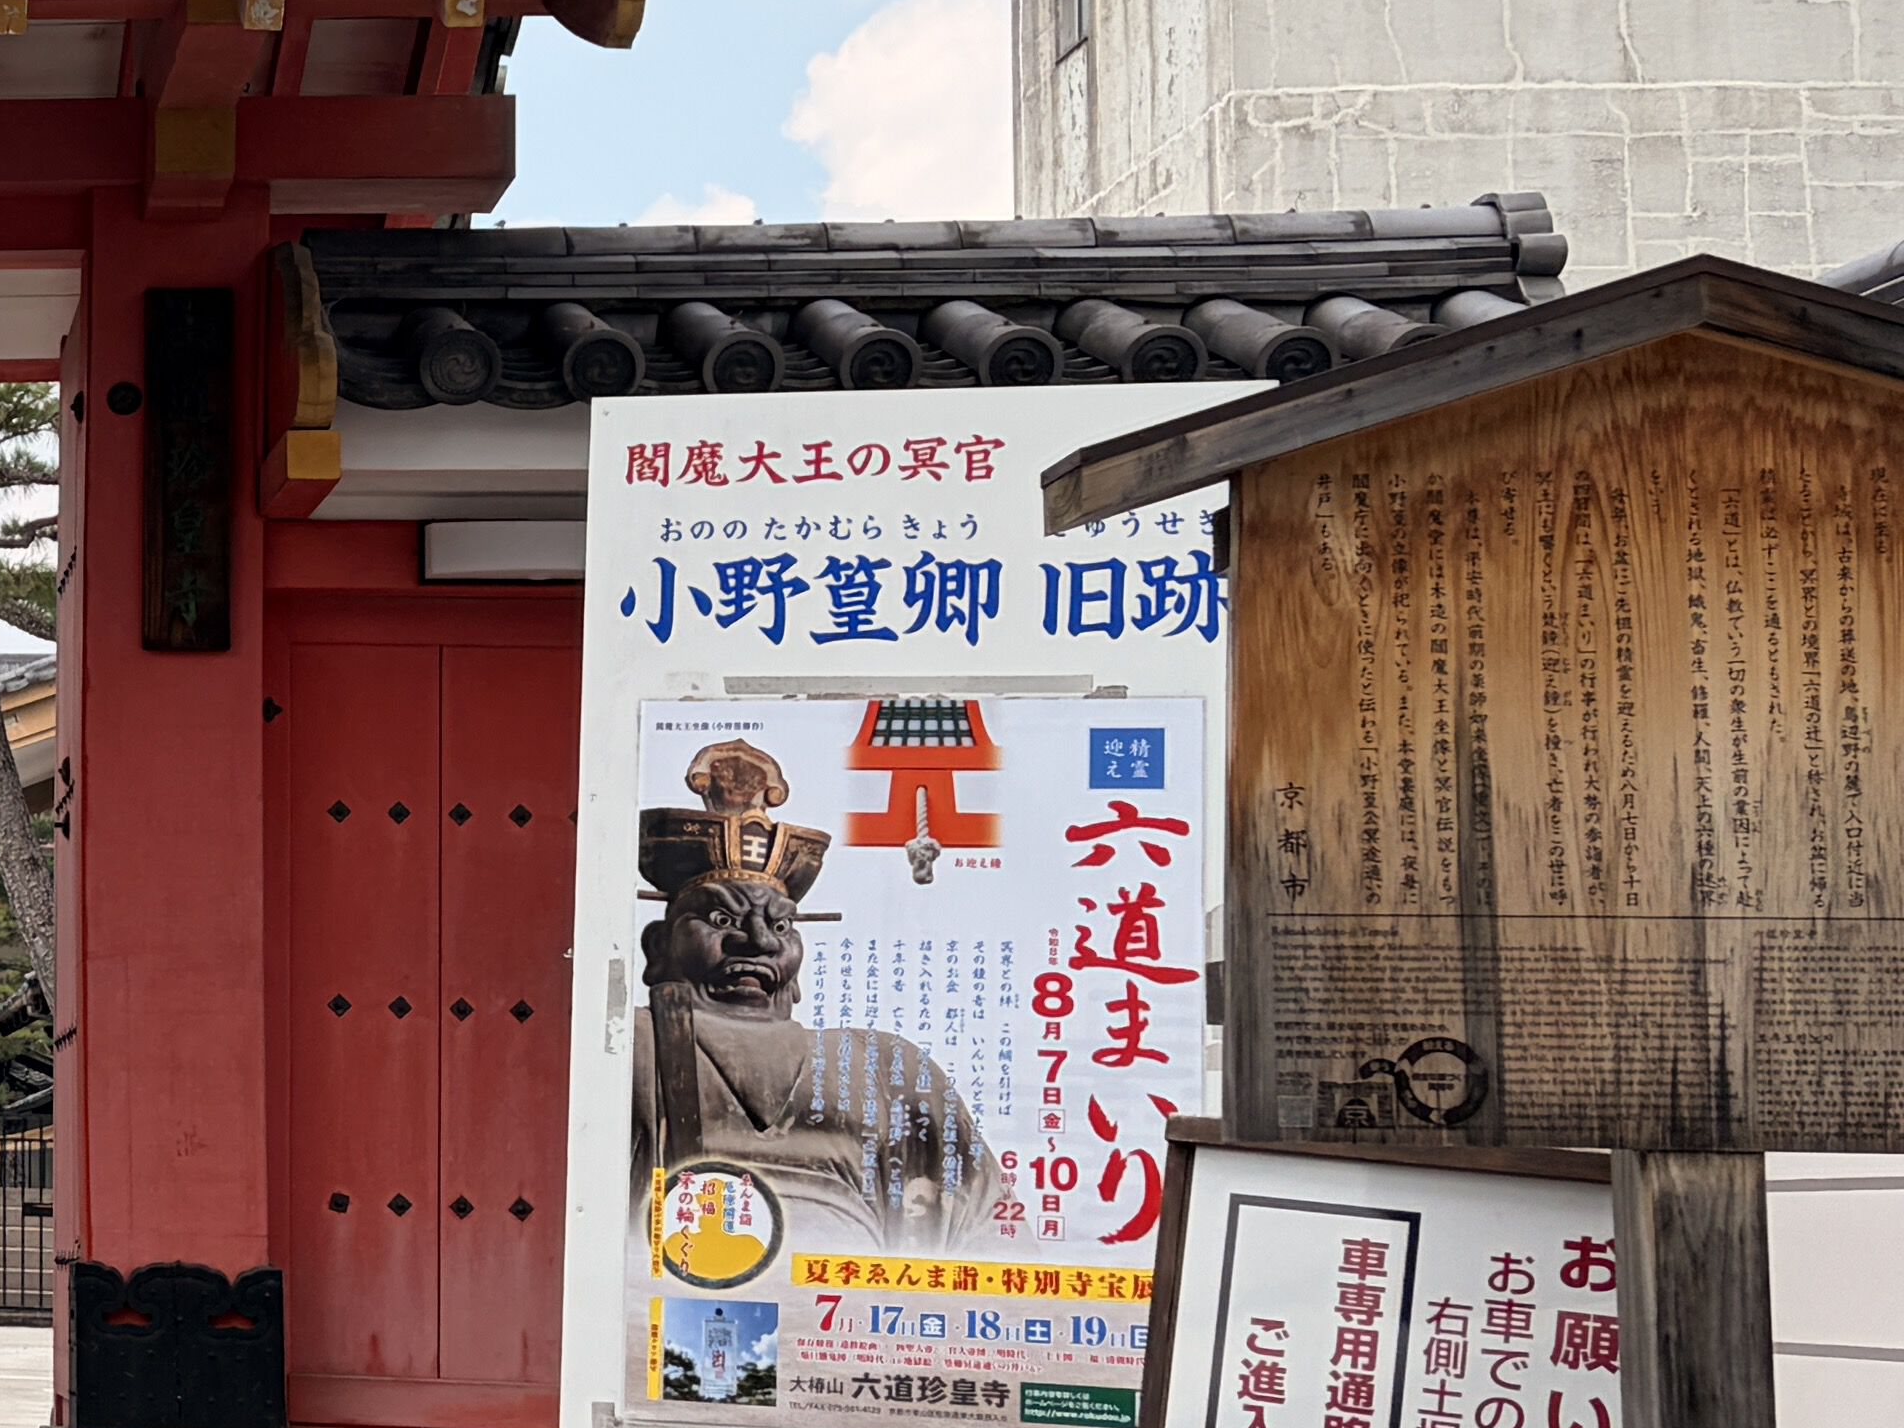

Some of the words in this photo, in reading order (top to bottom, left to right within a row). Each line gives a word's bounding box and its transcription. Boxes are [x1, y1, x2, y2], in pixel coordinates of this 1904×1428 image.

[625, 434, 1005, 487] 閻魔大王の冥官
[661, 515, 747, 542] おのの
[764, 515, 882, 542] たかむら
[901, 513, 980, 541] きょう
[1053, 509, 1214, 538] ゅうせき
[1315, 473, 1335, 581] 井戸」もある。
[620, 550, 1001, 646] 小野篁卿
[1043, 550, 1229, 645] 旧跡
[1104, 737, 1125, 778] 迎え
[1129, 737, 1150, 778] 精霊
[1278, 781, 1308, 903] 京都市
[1065, 800, 1199, 1245] 六道まいり
[790, 1377, 843, 1395] 大椿山
[852, 1373, 1010, 1408] 六道珍皇寺
